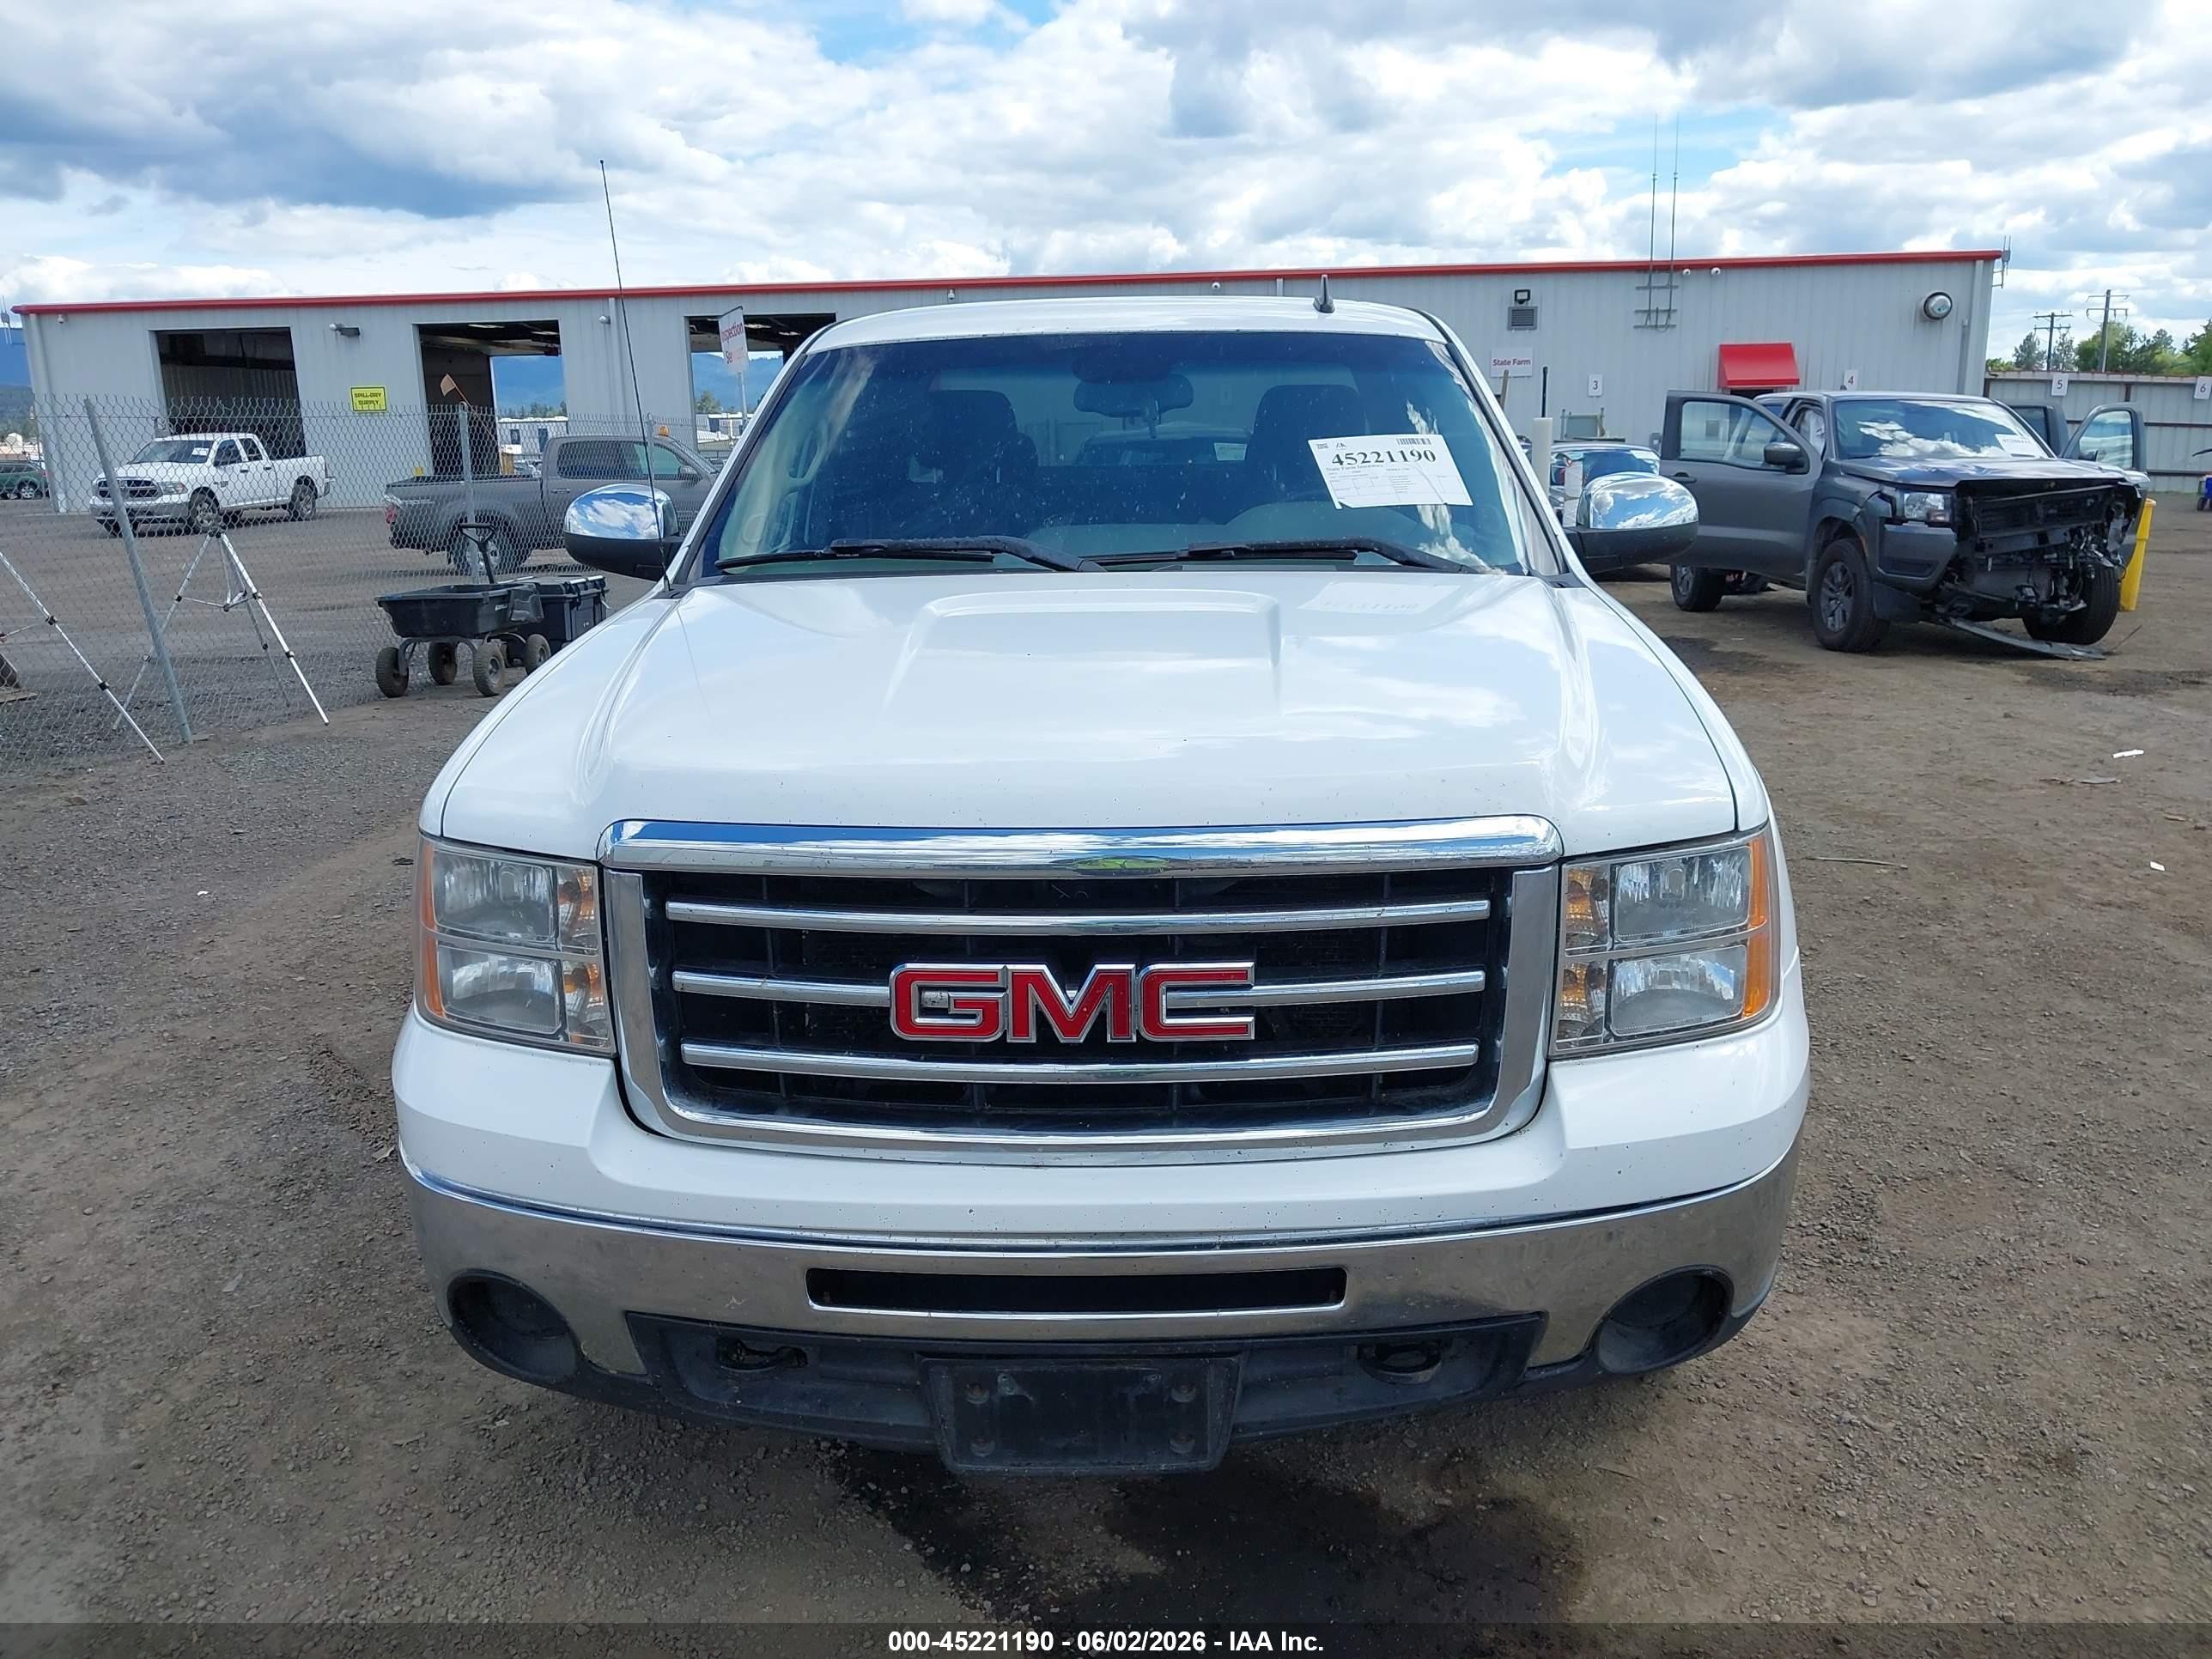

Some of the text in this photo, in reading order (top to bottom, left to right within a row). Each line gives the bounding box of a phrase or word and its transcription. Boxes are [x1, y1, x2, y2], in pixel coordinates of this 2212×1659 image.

[1492, 358, 1511, 367] State
[1592, 380, 1598, 390] 3
[1848, 375, 1854, 386] 4
[2057, 379, 2063, 389] 5
[2200, 384, 2207, 392] 6
[1332, 449, 1437, 465] 45221190
[890, 962, 1255, 1043] GMC
